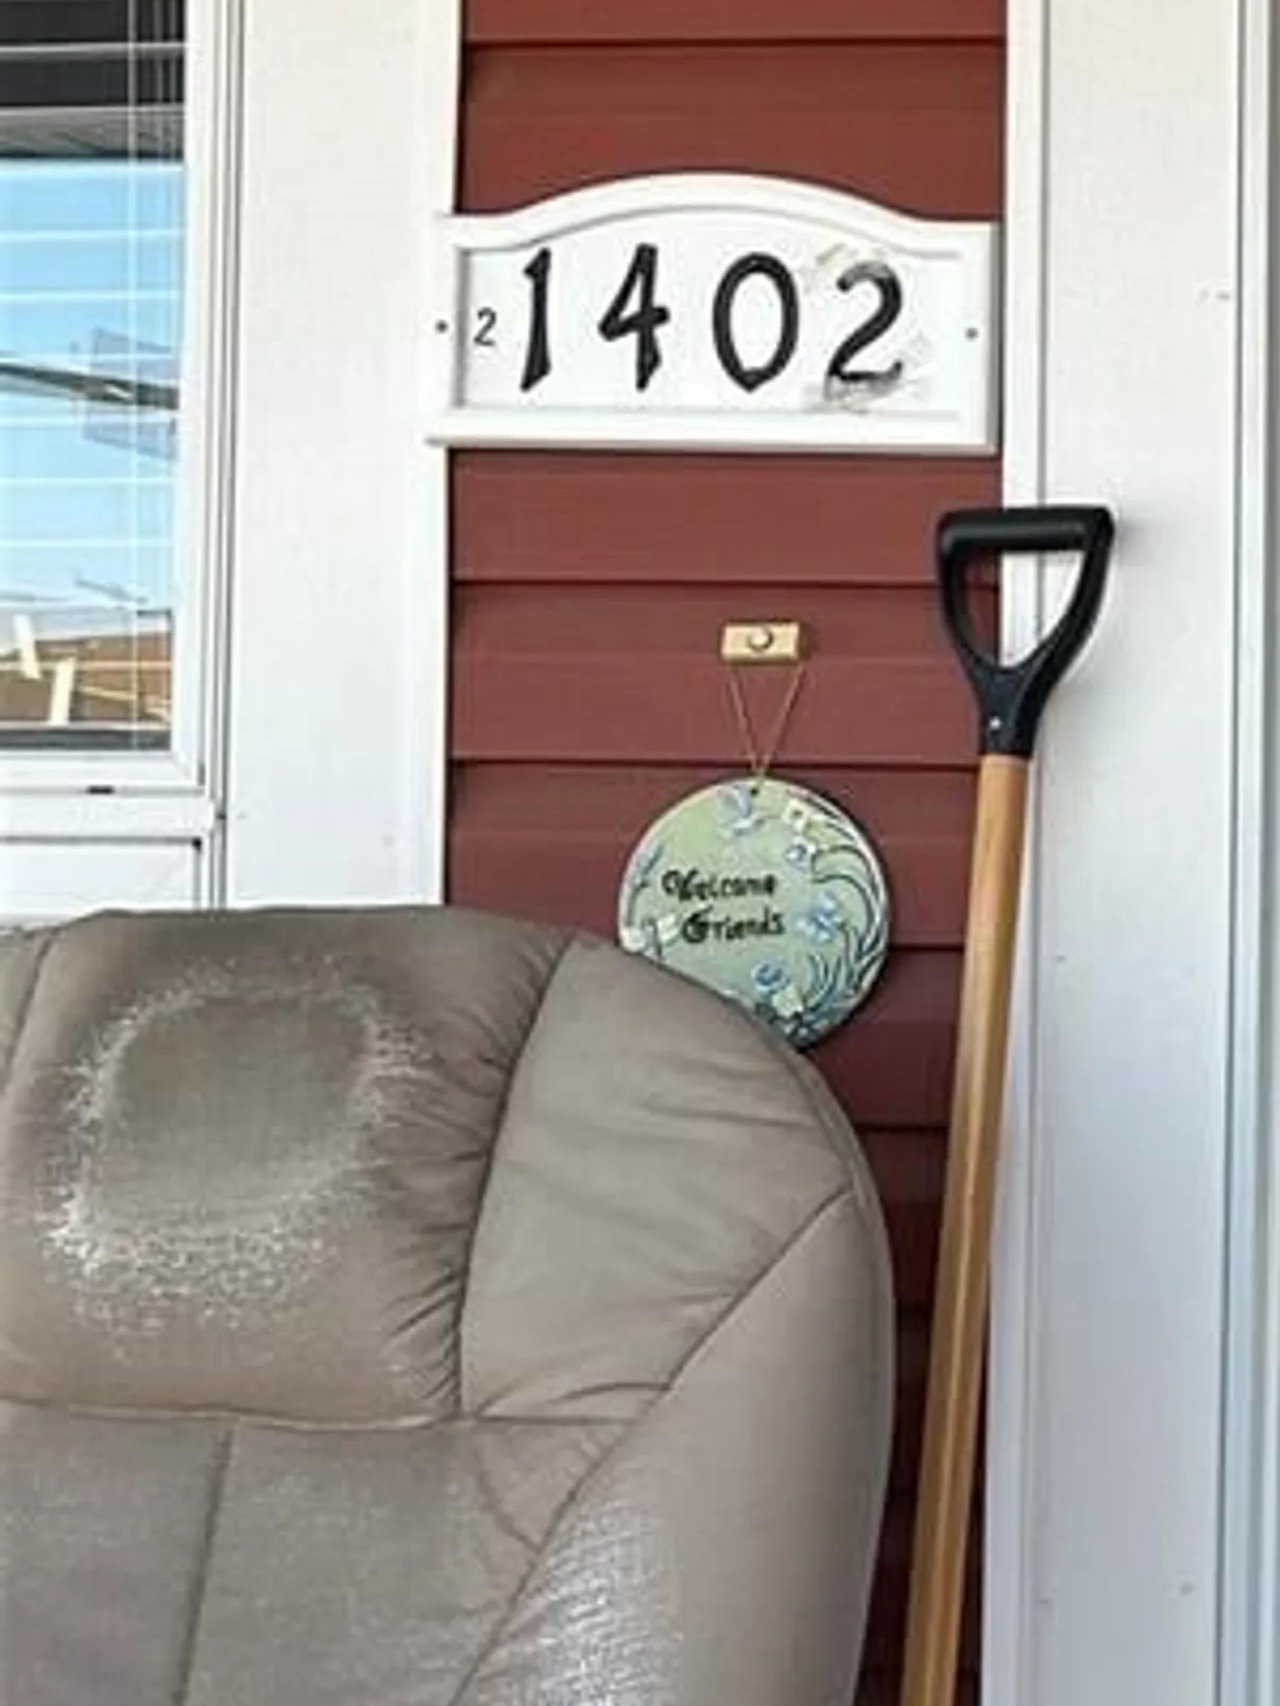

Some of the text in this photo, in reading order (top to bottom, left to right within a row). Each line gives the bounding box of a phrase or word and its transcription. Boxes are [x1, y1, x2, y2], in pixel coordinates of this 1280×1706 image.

[474, 244, 903, 399] 2 1402
[681, 904, 785, 945] Friends
